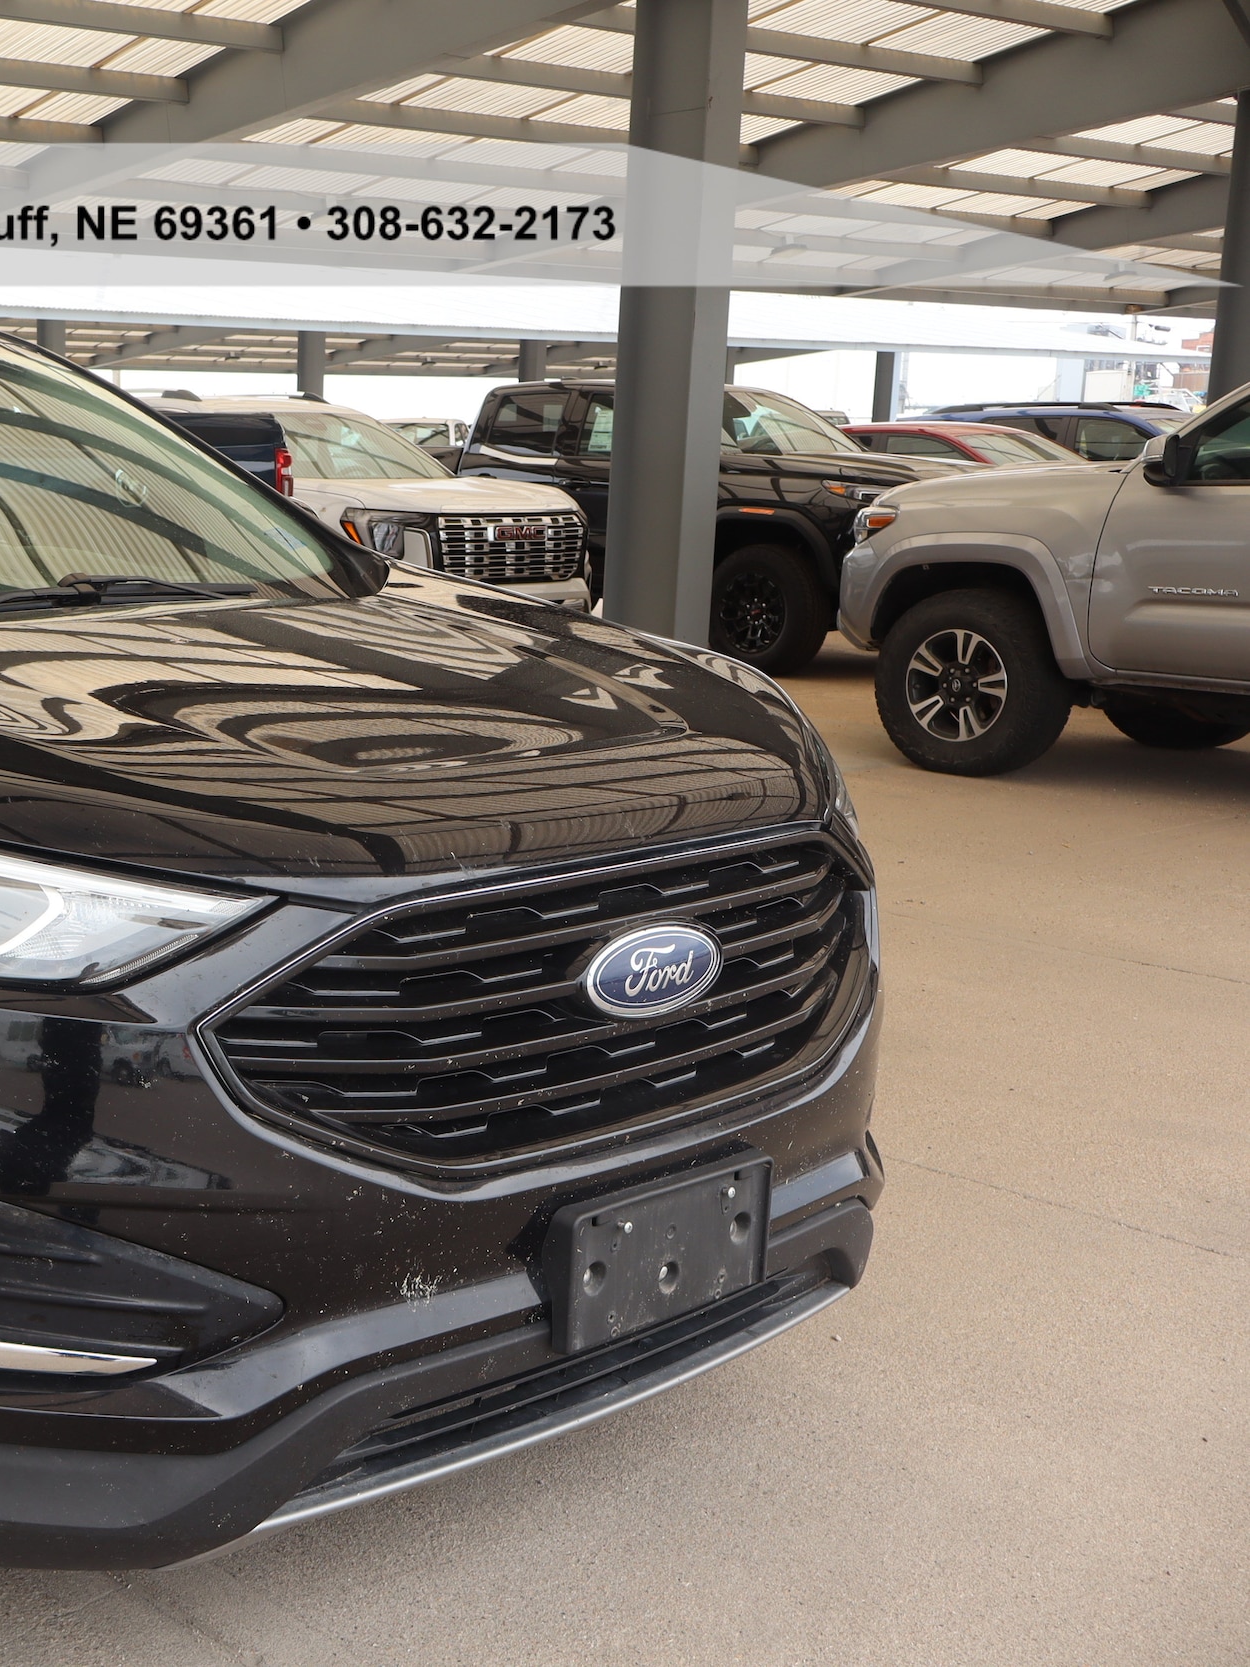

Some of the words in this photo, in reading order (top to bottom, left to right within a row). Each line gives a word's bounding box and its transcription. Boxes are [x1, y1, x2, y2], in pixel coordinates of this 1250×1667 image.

[495, 526, 547, 541] GMC
[1147, 586, 1239, 597] TACOMA
[625, 943, 694, 997] Ford
